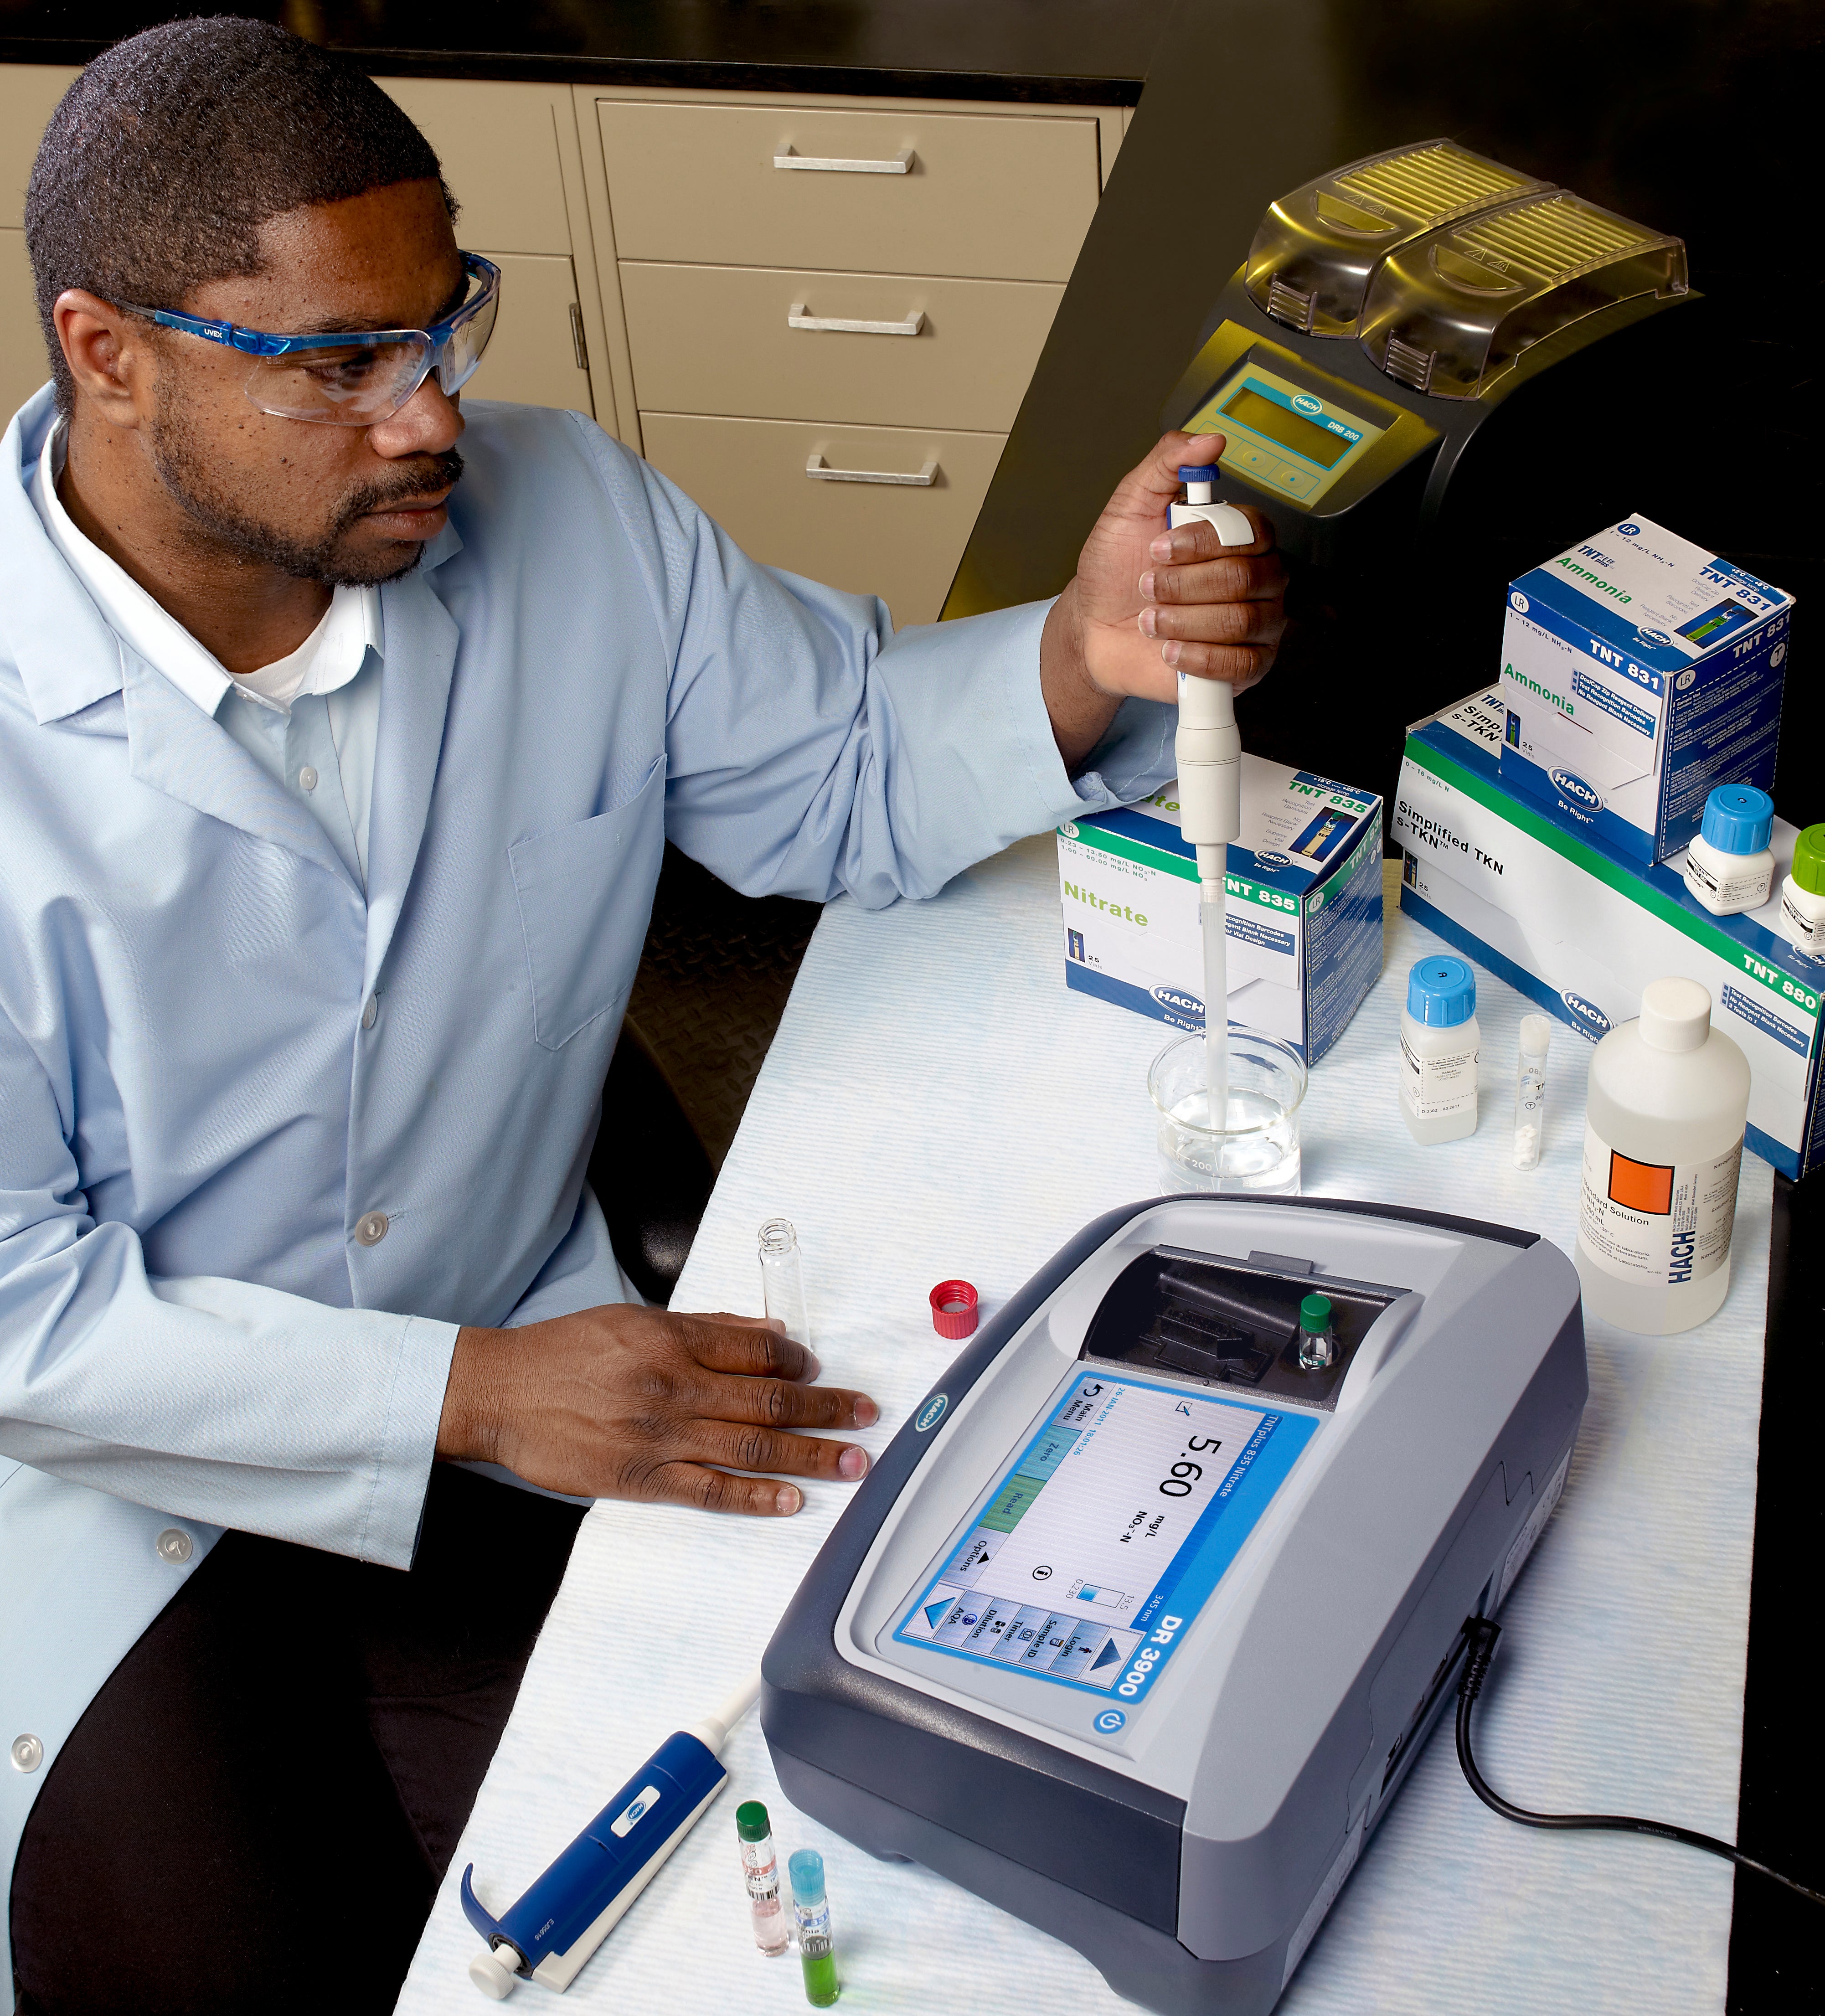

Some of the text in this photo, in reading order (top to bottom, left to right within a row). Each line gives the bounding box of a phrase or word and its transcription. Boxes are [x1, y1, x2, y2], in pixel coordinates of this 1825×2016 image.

[204, 328, 222, 338] UVEX
[1295, 397, 1319, 411] HACH
[1327, 422, 1359, 441] DRB 200
[1621, 525, 1636, 535] LR
[1632, 543, 1650, 554] mg/L
[1555, 557, 1632, 604] Ammonia
[1699, 567, 1771, 611] TNT 831
[1729, 574, 1760, 592] storage temp
[1514, 595, 1525, 609] LR
[1666, 594, 1694, 611] Recognition
[1691, 590, 1710, 602] Delivery
[1666, 601, 1688, 614] Barcodes
[1643, 612, 1667, 627] Necessary
[1659, 615, 1673, 624] Blank
[1522, 620, 1529, 628] 12
[1532, 627, 1549, 640] mg/L
[1641, 628, 1670, 645] HACH
[1733, 612, 1790, 658] TNT 831
[1590, 639, 1659, 690] TNT 831
[1504, 663, 1574, 715] Ammonia
[1681, 674, 1690, 686] LR
[1579, 681, 1646, 725] Test Recognition Barcodes
[1580, 674, 1655, 723] DosiCap Zip Reagent Delivery
[1586, 694, 1608, 710] Reagent
[1608, 706, 1623, 719] Blank
[1623, 716, 1650, 736] Necessary
[1522, 742, 1533, 751] 25
[1522, 747, 1535, 759] Vials
[1313, 777, 1332, 785] +15°C
[1427, 776, 1442, 788] mg/L
[1555, 773, 1597, 804] HACH
[1288, 781, 1367, 813] TNT 835
[1316, 784, 1350, 797] storage temp
[1282, 798, 1312, 810] Recognition
[1284, 804, 1308, 815] Barcodes
[1558, 800, 1568, 810] Be
[1262, 812, 1298, 826] Reagent Blank
[1268, 820, 1294, 831] Necessary
[1064, 824, 1074, 835] LR
[1266, 829, 1287, 838] Superior
[1398, 800, 1504, 876] Simplified TKN
[1061, 838, 1076, 847] 0.23
[1086, 848, 1107, 859] 13.50
[1110, 857, 1129, 866] mg/L
[1262, 839, 1280, 847] Design
[1062, 845, 1077, 854] 1.00
[1086, 855, 1107, 865] 60.00
[1110, 864, 1129, 874] mg/L
[1258, 852, 1289, 864] HACH
[1350, 839, 1367, 869] TNT
[1418, 887, 1431, 900] Tests
[1419, 882, 1428, 892] 25
[1064, 880, 1148, 927] Nitrate
[1259, 890, 1295, 910] 835
[1242, 927, 1258, 936] Blank
[1260, 933, 1290, 947] Necessary
[1245, 935, 1265, 945] Design
[1257, 925, 1284, 938] Barcodes
[1088, 960, 1103, 969] Vials
[1743, 954, 1778, 985] TNT
[1782, 981, 1816, 1009] 880
[1157, 990, 1204, 1013] HACH
[1164, 1014, 1175, 1023] Be
[1567, 995, 1608, 1028] HACH
[1731, 989, 1798, 1035] Test Recognition Barcodes
[1733, 1005, 1747, 1017] Tests
[1571, 1021, 1581, 1031] Be
[1737, 1001, 1760, 1018] Reagent
[1761, 1016, 1776, 1029] Blank
[1777, 1026, 1805, 1047] Necessary
[1192, 1160, 1212, 1171] 200
[1583, 1177, 1649, 1226] Standard Solution
[1595, 1216, 1604, 1226] mL
[1668, 1230, 1696, 1284] HACH
[920, 1398, 943, 1427] HACH
[1063, 1400, 1083, 1420] Menu
[1076, 1403, 1093, 1421] Main
[1073, 1387, 1126, 1456] 26-JAN-2011 18:01:26
[1040, 1443, 1059, 1461] Zero
[1220, 1416, 1279, 1497] TNTplus 835 Nitrate
[1159, 1435, 1222, 1497] 5.60
[1002, 1492, 1024, 1515] Read
[1145, 1515, 1165, 1538] mg/L
[960, 1541, 987, 1572] Options
[1066, 1579, 1083, 1599] 0.230
[1120, 1595, 1134, 1610] 13.5
[1141, 1594, 1164, 1622] 345 nm
[948, 1607, 964, 1624] AQA
[972, 1609, 997, 1638] Dilution
[1004, 1621, 1024, 1642] Timer
[1027, 1620, 1057, 1658] Sample ID
[1061, 1636, 1081, 1657] Login
[1119, 1615, 1183, 1696] DR 3900
[629, 1803, 643, 1819] HACH
